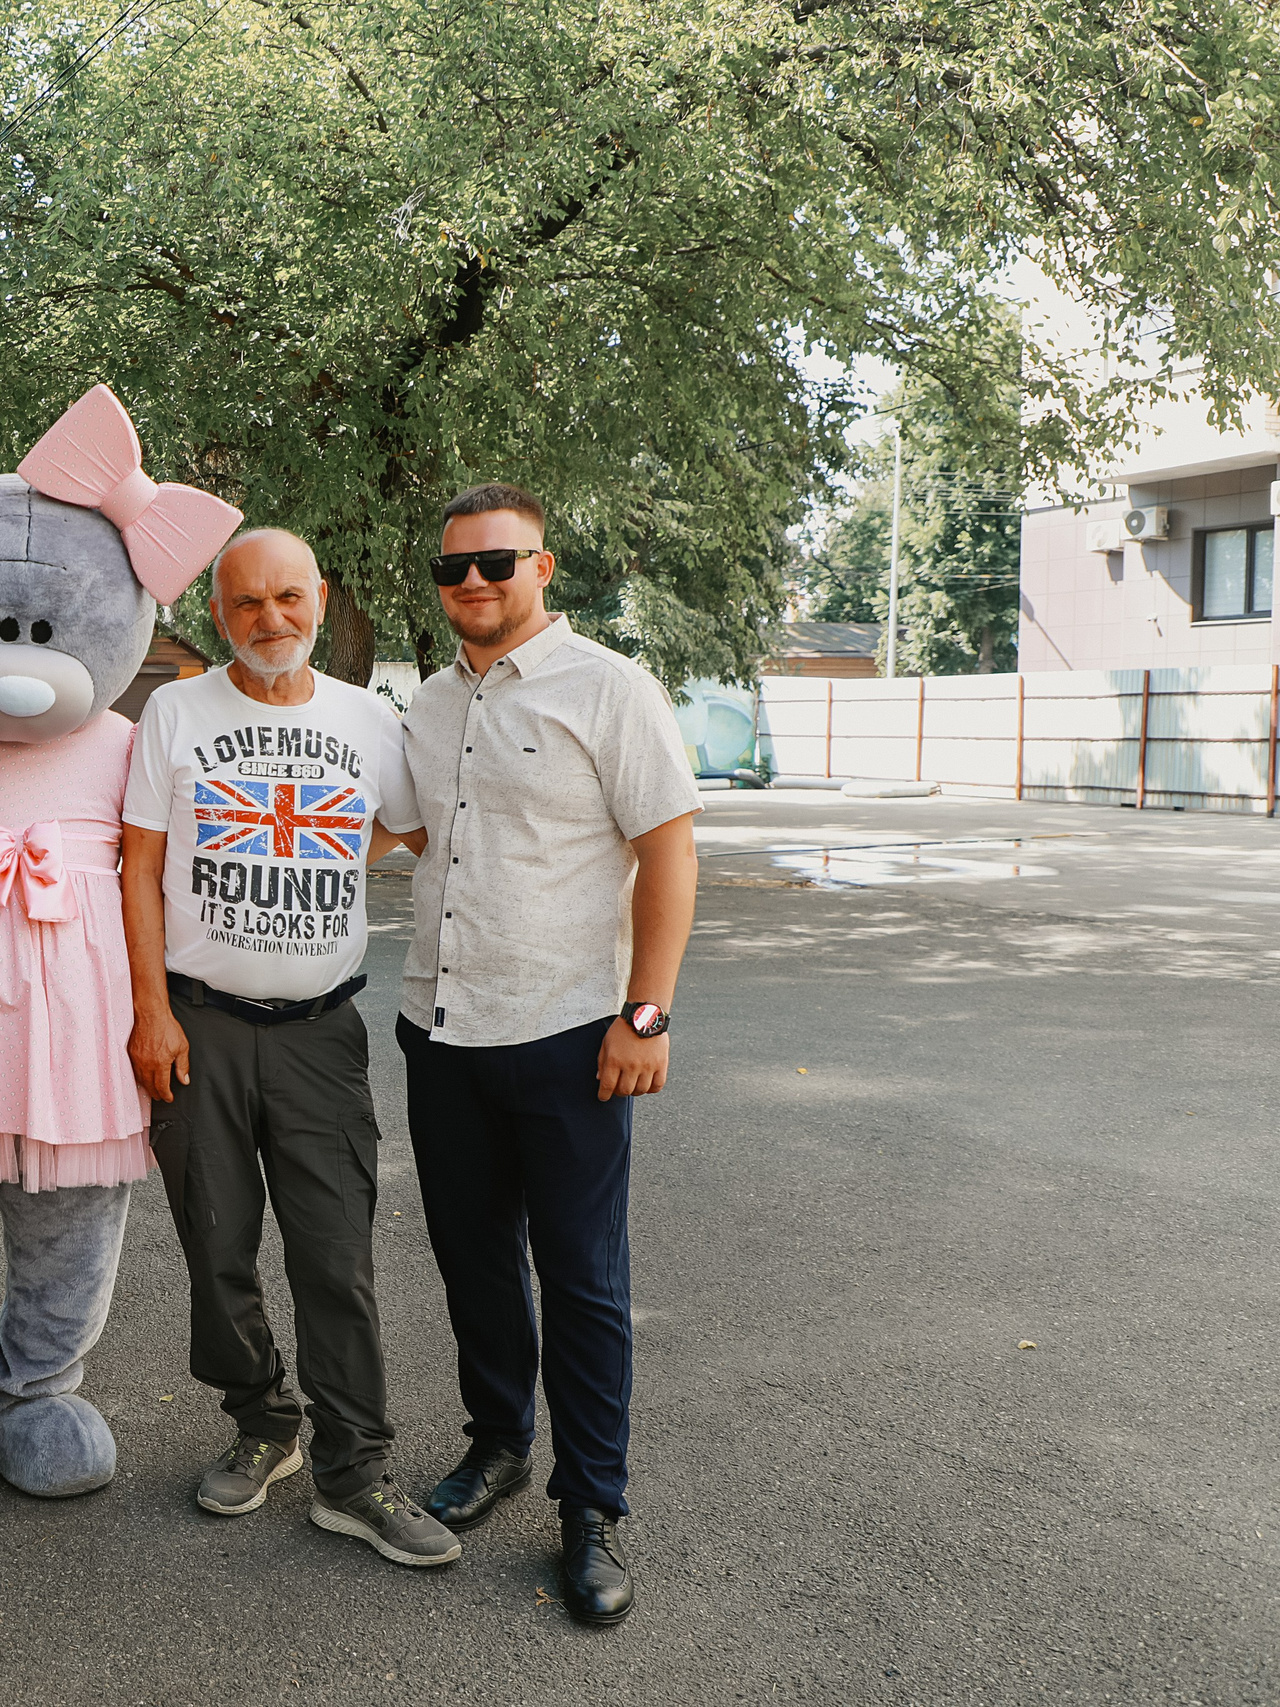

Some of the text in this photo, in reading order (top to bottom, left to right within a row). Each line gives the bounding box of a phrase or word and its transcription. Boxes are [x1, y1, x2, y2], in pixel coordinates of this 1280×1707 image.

[240, 762, 322, 778] SINCE 860
[192, 856, 360, 912] ROUNDS
[243, 908, 316, 940] LOOKS
[322, 913, 349, 940] FOR
[206, 927, 284, 955] CONVERSATION
